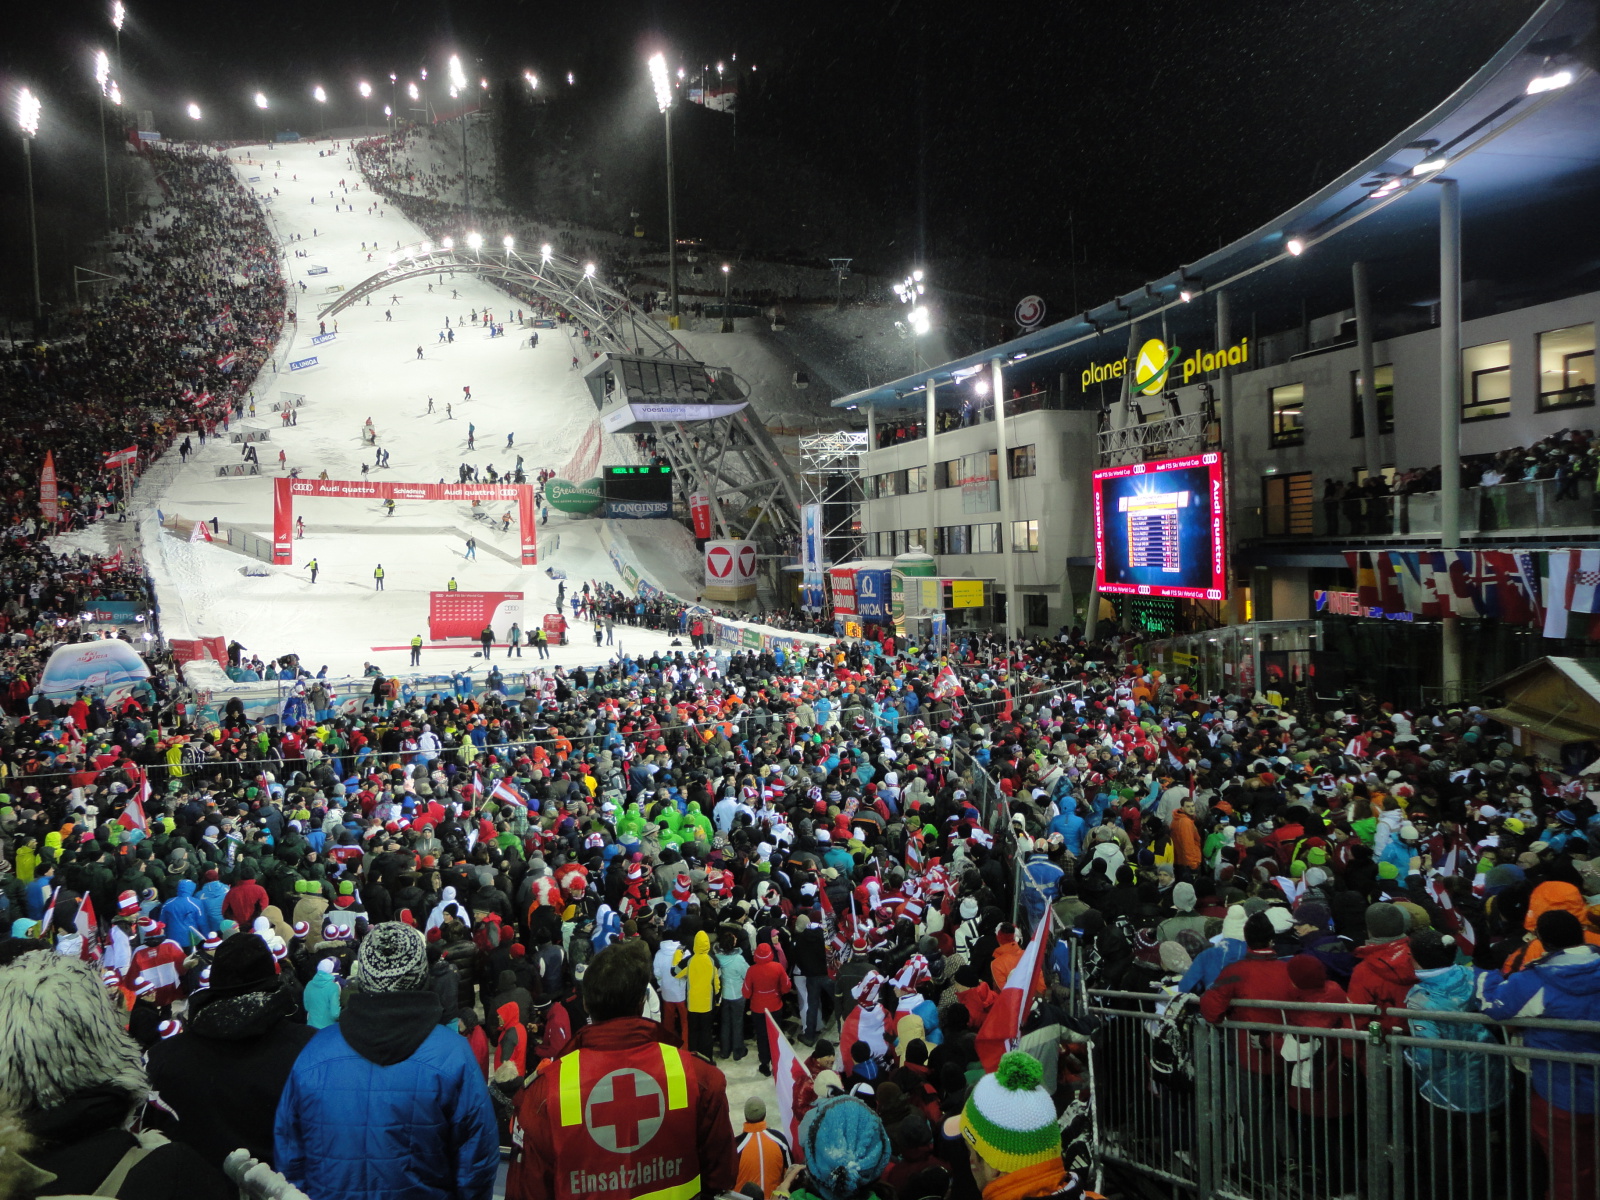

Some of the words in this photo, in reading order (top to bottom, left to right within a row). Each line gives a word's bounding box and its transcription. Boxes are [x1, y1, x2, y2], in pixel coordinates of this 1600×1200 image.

[300, 358, 317, 368] UNIQA
[1081, 356, 1128, 392] planet
[1183, 337, 1248, 384] planai
[464, 489, 495, 497] quattro
[1213, 480, 1221, 514] Audi
[611, 503, 668, 513] LONGINES
[1213, 517, 1221, 574] quattro
[858, 603, 881, 616] UNIQA
[570, 1156, 683, 1194] Einsatzleiter
